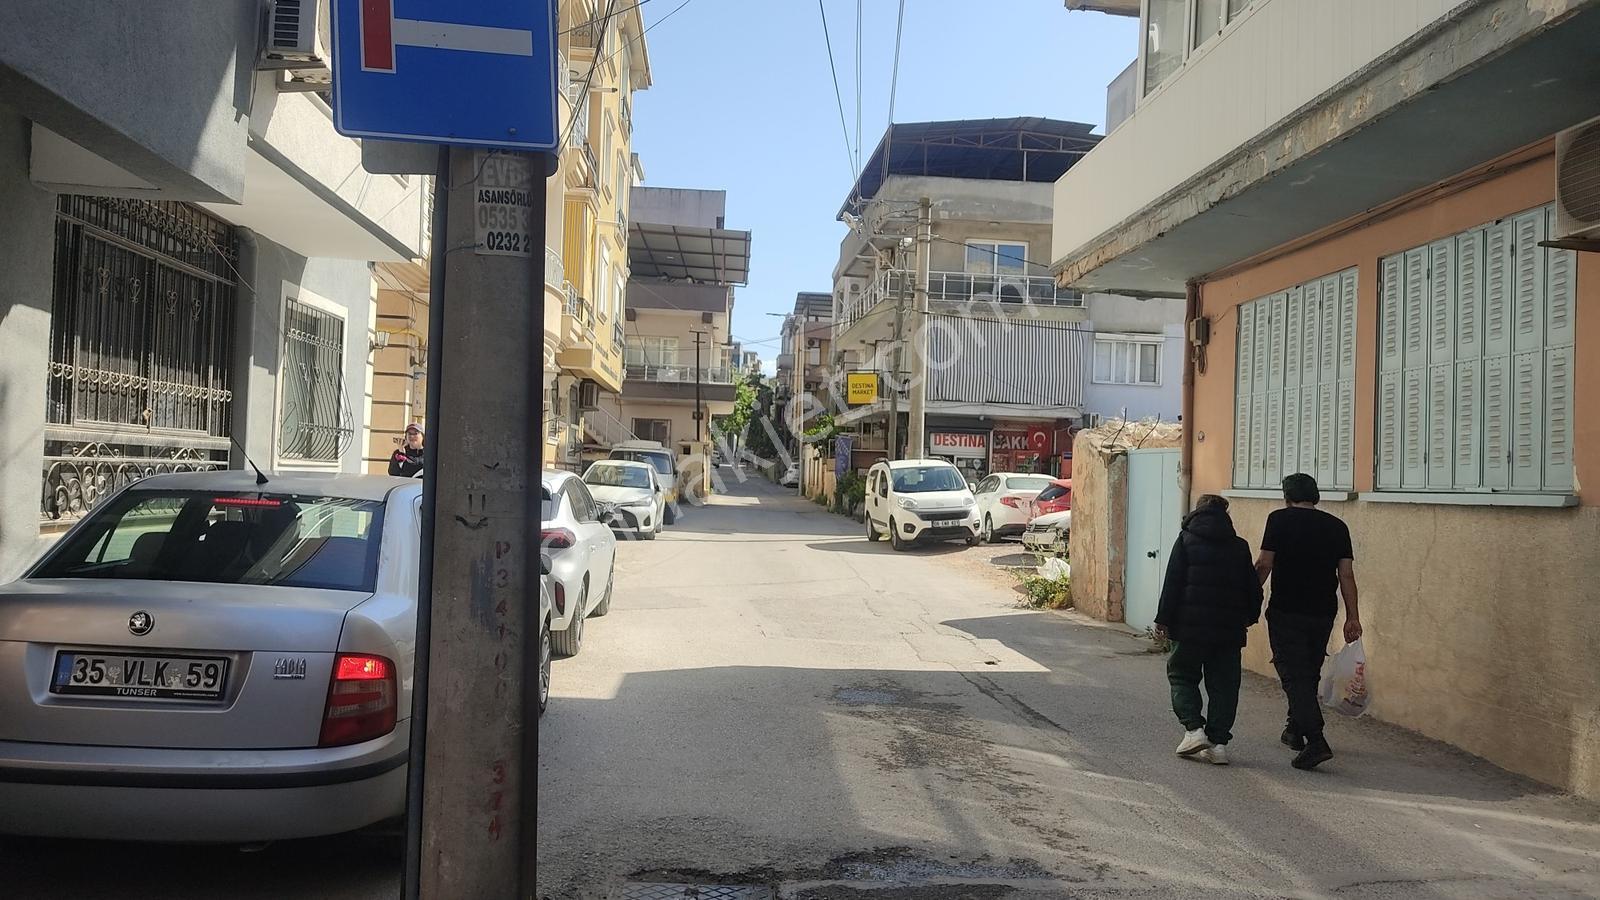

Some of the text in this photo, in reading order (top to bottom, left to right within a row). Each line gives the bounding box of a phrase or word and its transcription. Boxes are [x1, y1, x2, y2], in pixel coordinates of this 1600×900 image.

[478, 206, 518, 230] 0535
[486, 231, 520, 252] 0232
[72, 658, 219, 689] 35 VLK 59
[116, 687, 157, 697] TUNSER
